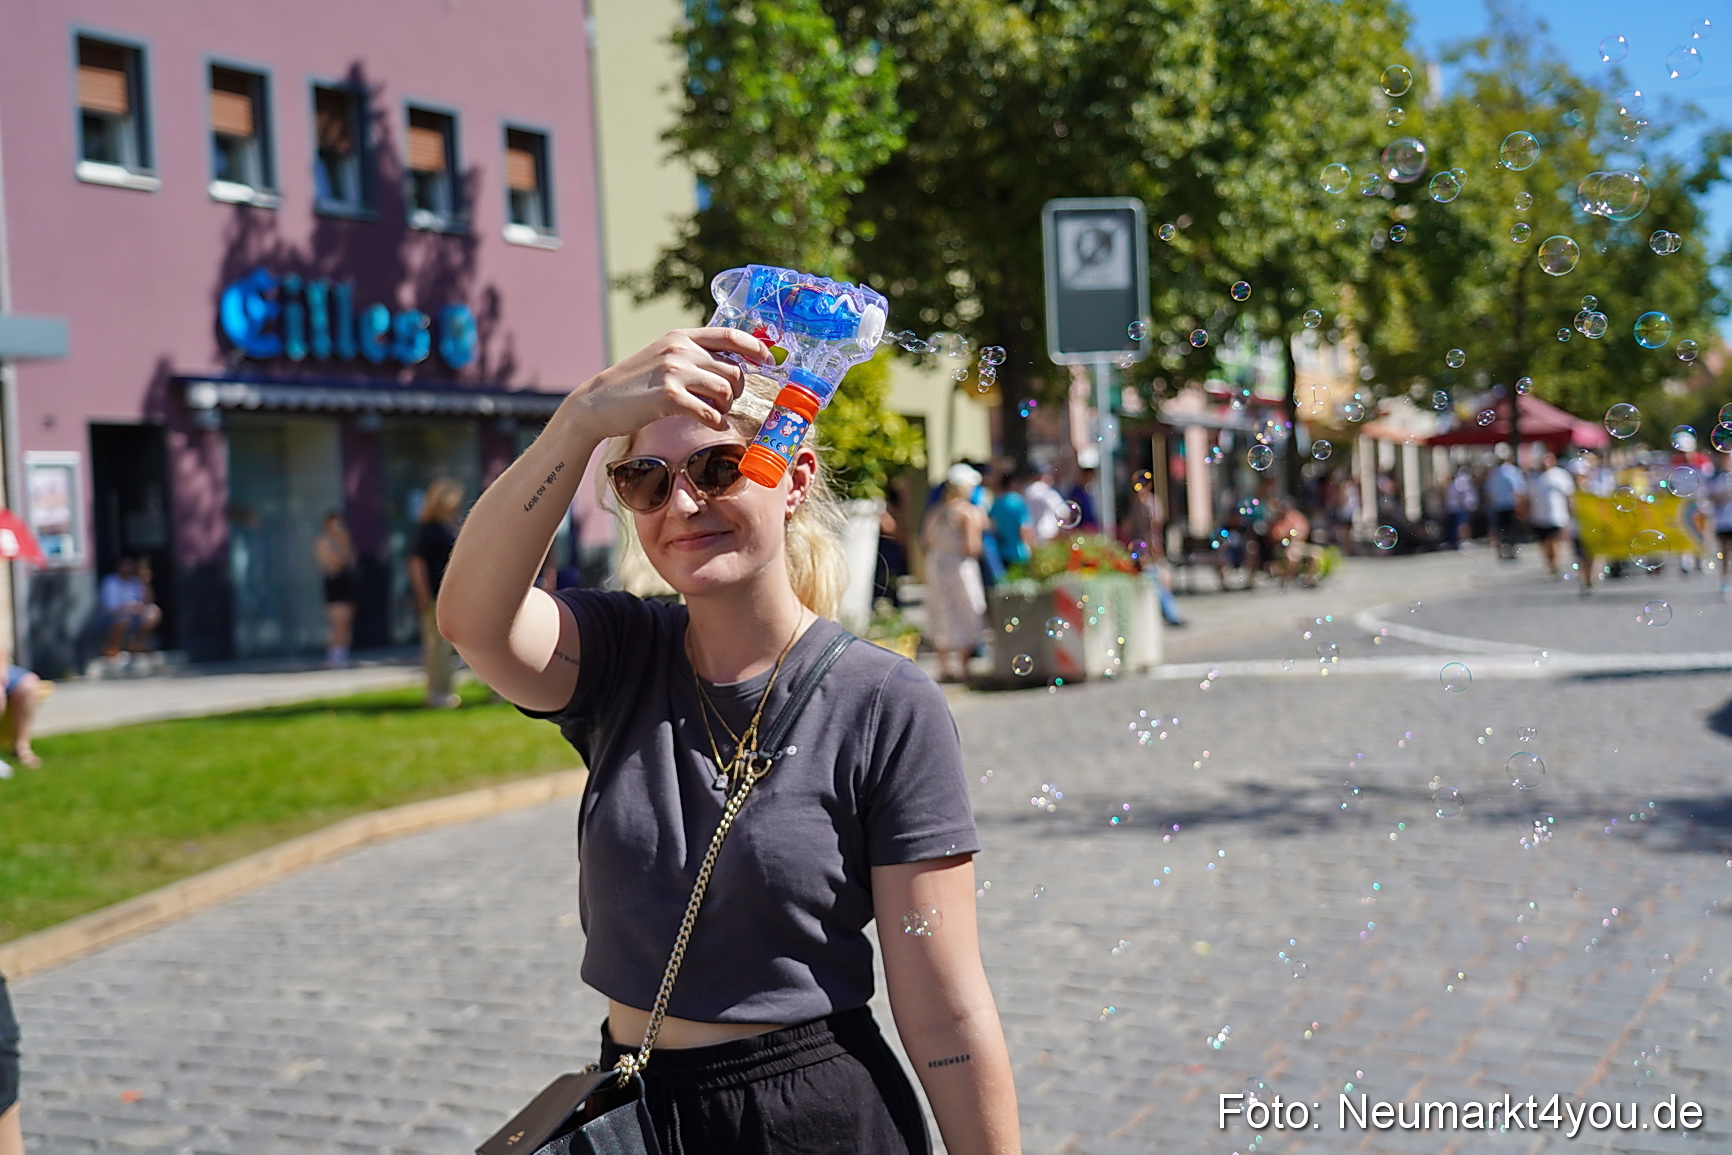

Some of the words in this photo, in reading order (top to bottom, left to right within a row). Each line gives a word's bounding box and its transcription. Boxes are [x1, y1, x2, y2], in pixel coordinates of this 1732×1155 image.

[555, 462, 565, 472] no
[536, 485, 546, 496] no
[928, 1053, 971, 1068] REMEMBER
